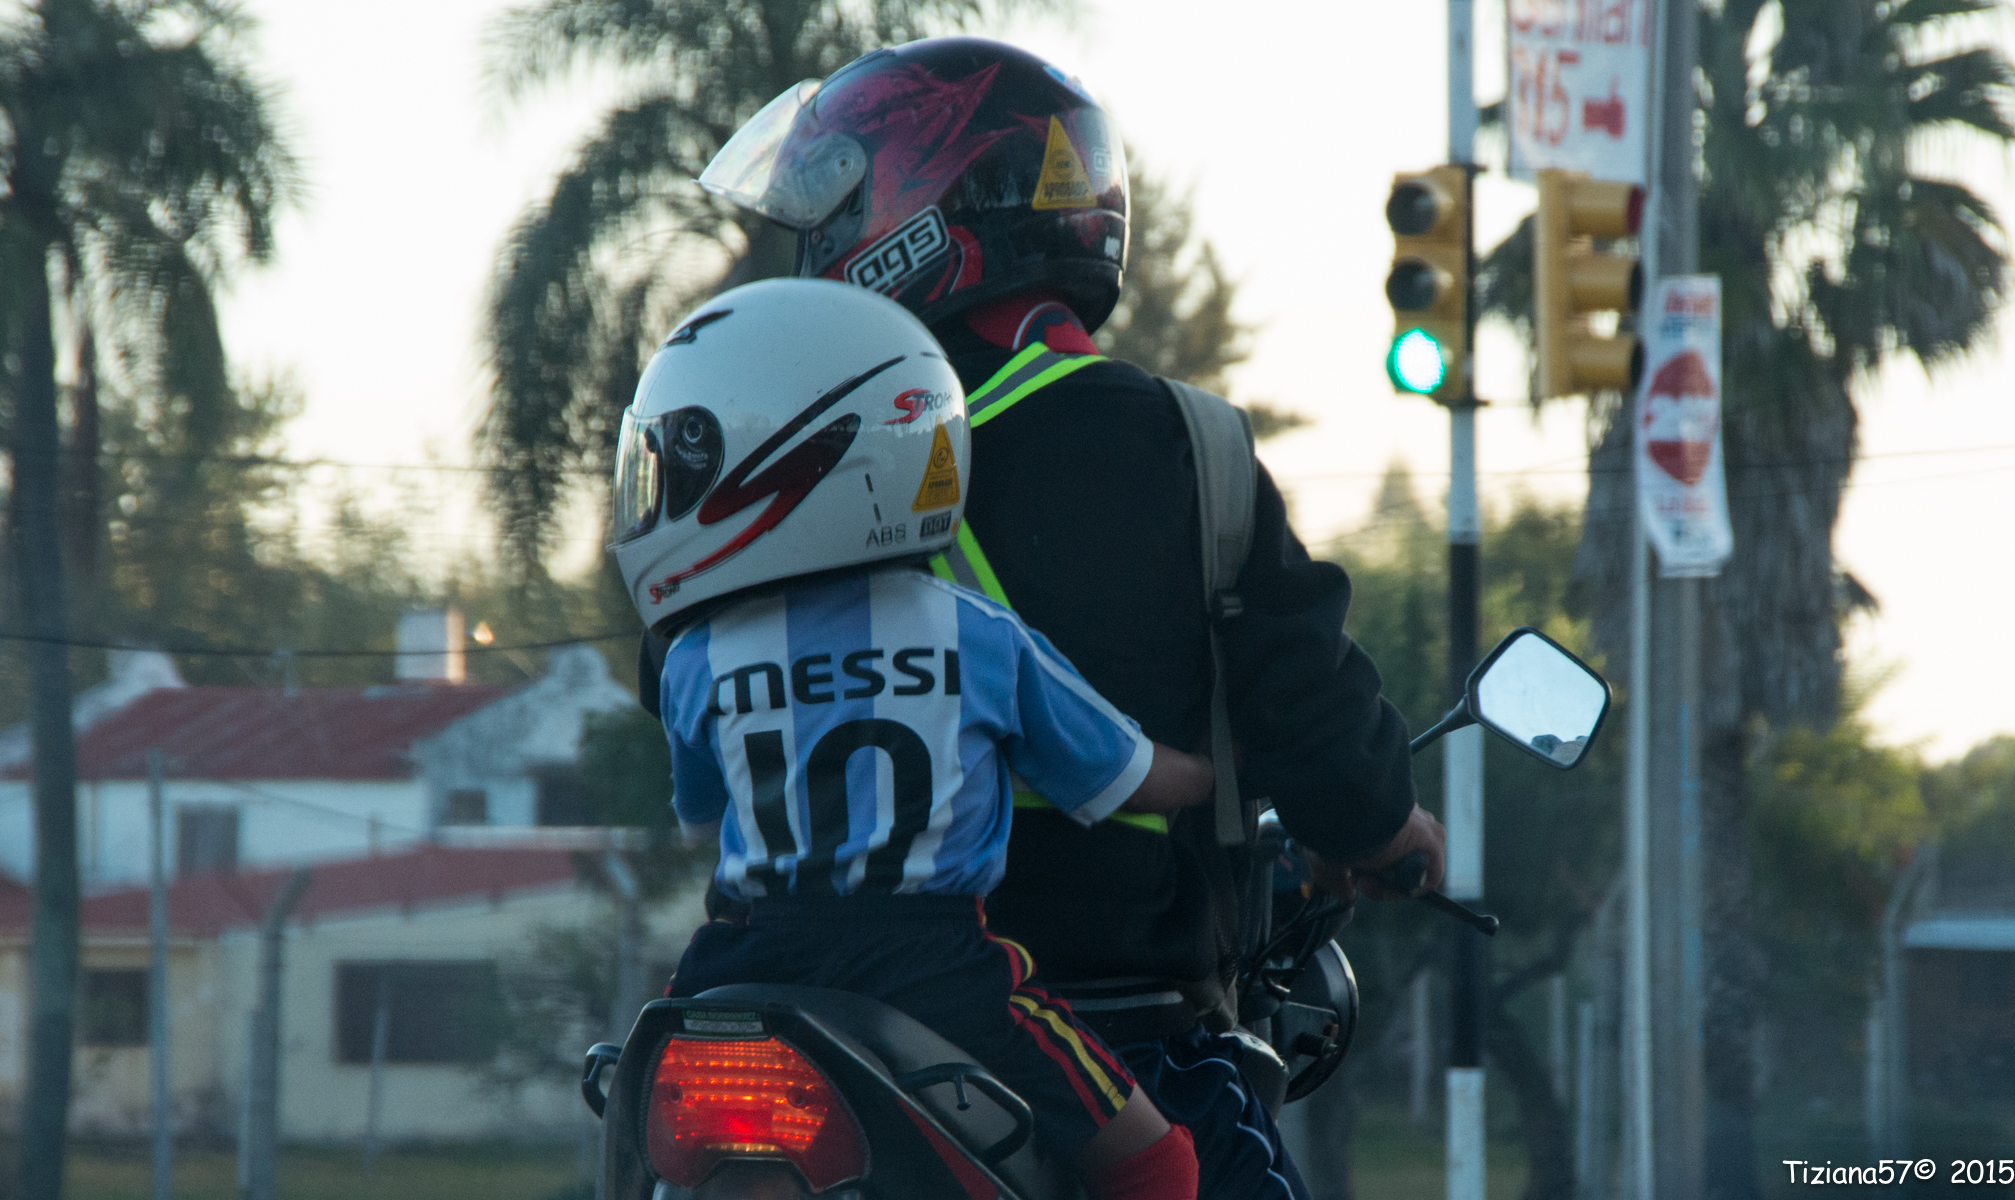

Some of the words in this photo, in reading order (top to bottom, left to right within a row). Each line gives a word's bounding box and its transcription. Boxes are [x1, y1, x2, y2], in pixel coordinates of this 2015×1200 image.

[865, 523, 907, 549] ABS
[706, 646, 961, 716] MESSI
[743, 717, 932, 896] 10
